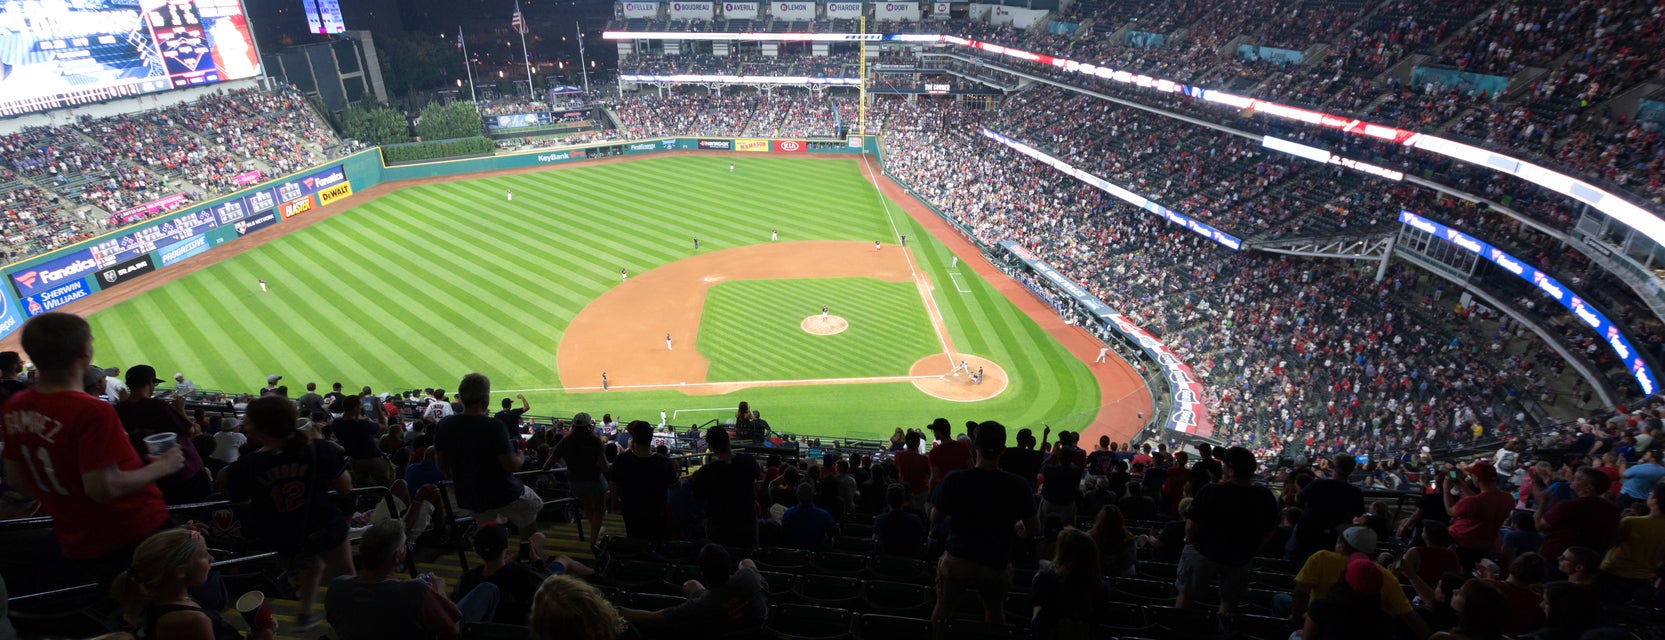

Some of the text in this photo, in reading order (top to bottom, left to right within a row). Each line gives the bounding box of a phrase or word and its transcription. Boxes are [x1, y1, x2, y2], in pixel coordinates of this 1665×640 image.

[538, 152, 570, 162] KeyBank
[314, 172, 344, 188] Fanatics
[162, 236, 206, 264] PROGRESSIVE
[40, 258, 97, 284] Fanatics
[118, 260, 148, 276] RAM
[41, 282, 81, 301] SHERWIN
[433, 409, 442, 418] 12
[20, 444, 70, 496] 11
[271, 480, 305, 512] 12
